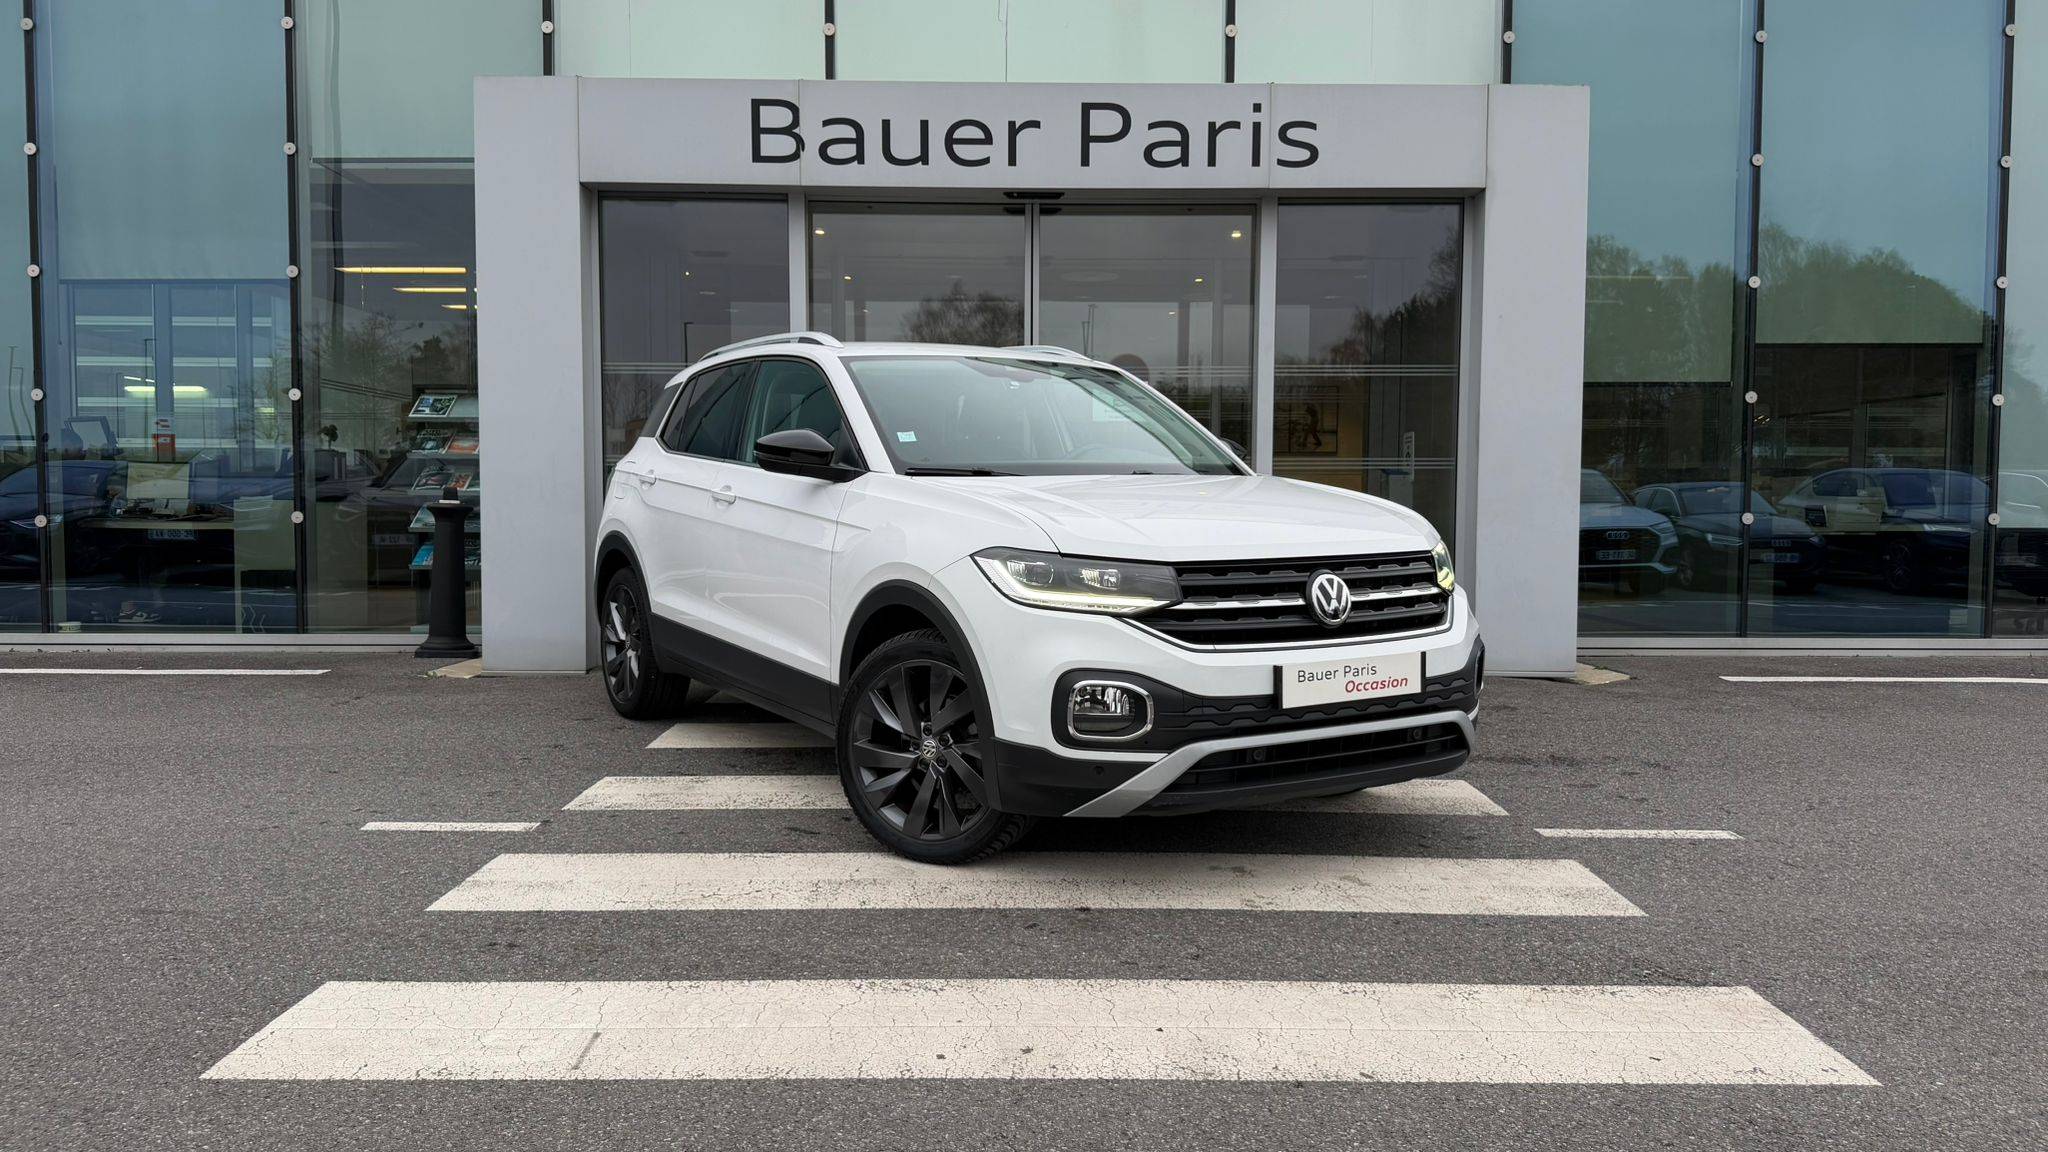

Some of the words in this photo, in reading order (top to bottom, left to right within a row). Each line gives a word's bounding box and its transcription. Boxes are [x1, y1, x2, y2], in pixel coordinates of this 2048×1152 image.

[751, 98, 1042, 169] Bauer
[1081, 102, 1320, 169] Paris
[1311, 573, 1351, 624] VW
[1297, 669, 1339, 683] Bauer
[1343, 663, 1377, 678] Paris
[1344, 676, 1408, 693] Occasion
